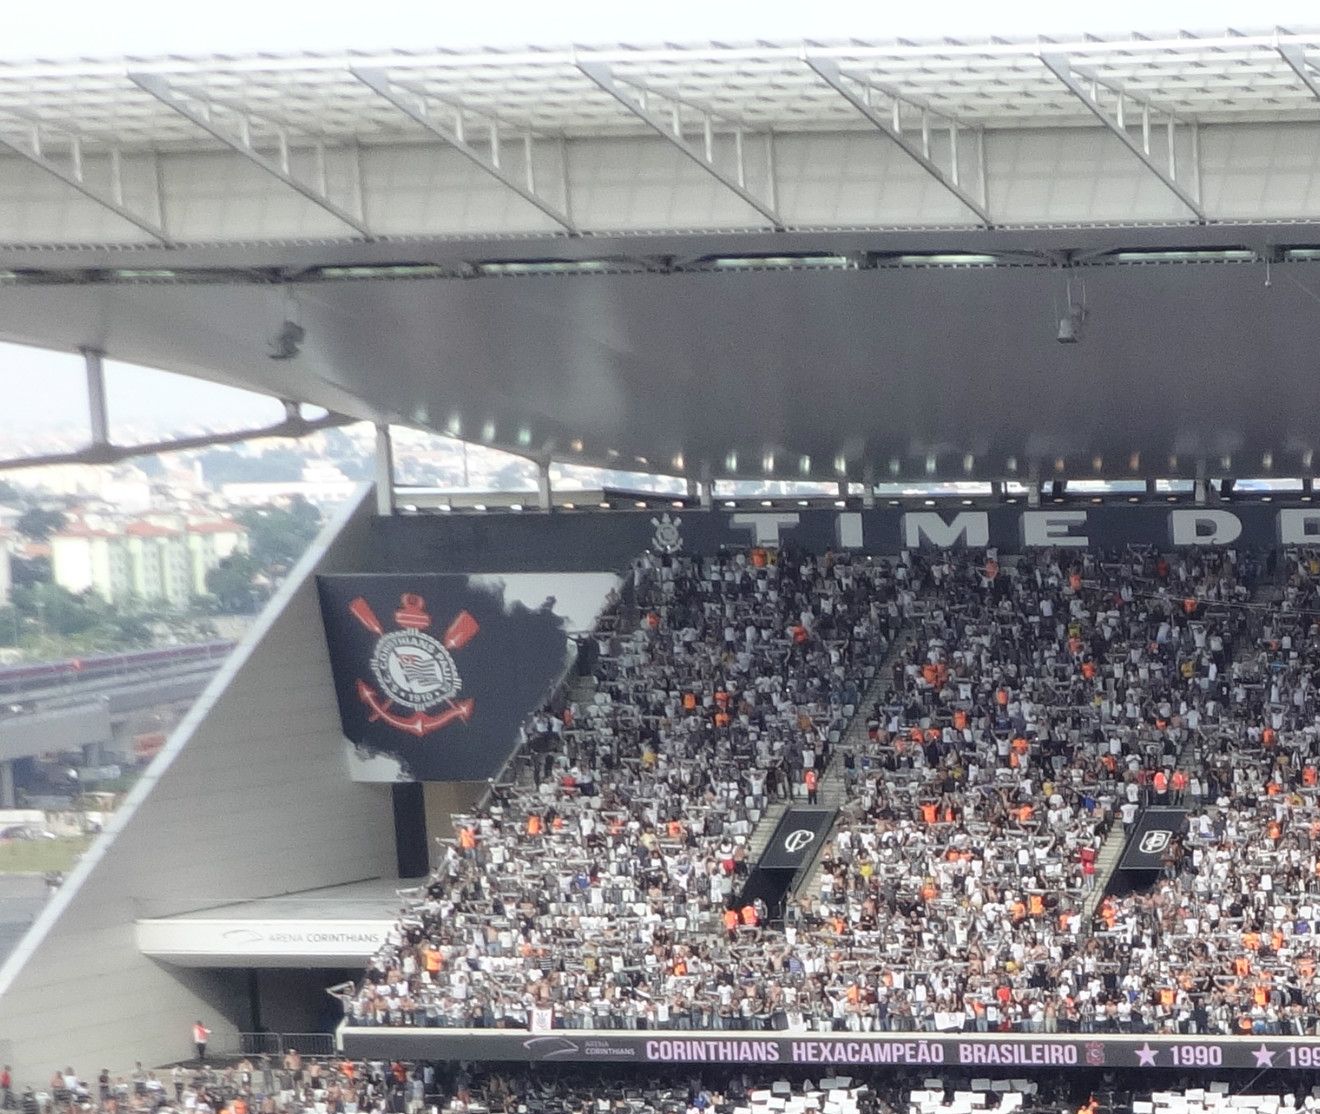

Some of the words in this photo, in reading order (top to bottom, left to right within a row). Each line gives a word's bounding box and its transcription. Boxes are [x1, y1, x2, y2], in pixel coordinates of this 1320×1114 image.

[733, 508, 1090, 549] TIME
[306, 933, 379, 943] CORINTHIANS
[585, 1047, 635, 1056] CORINTHIANS
[646, 1040, 780, 1062] CORINTHIANS
[792, 1040, 944, 1064] HEXACAMPEÃO
[960, 1044, 1078, 1065] BRASILEIRO
[1169, 1045, 1223, 1067] 1990
